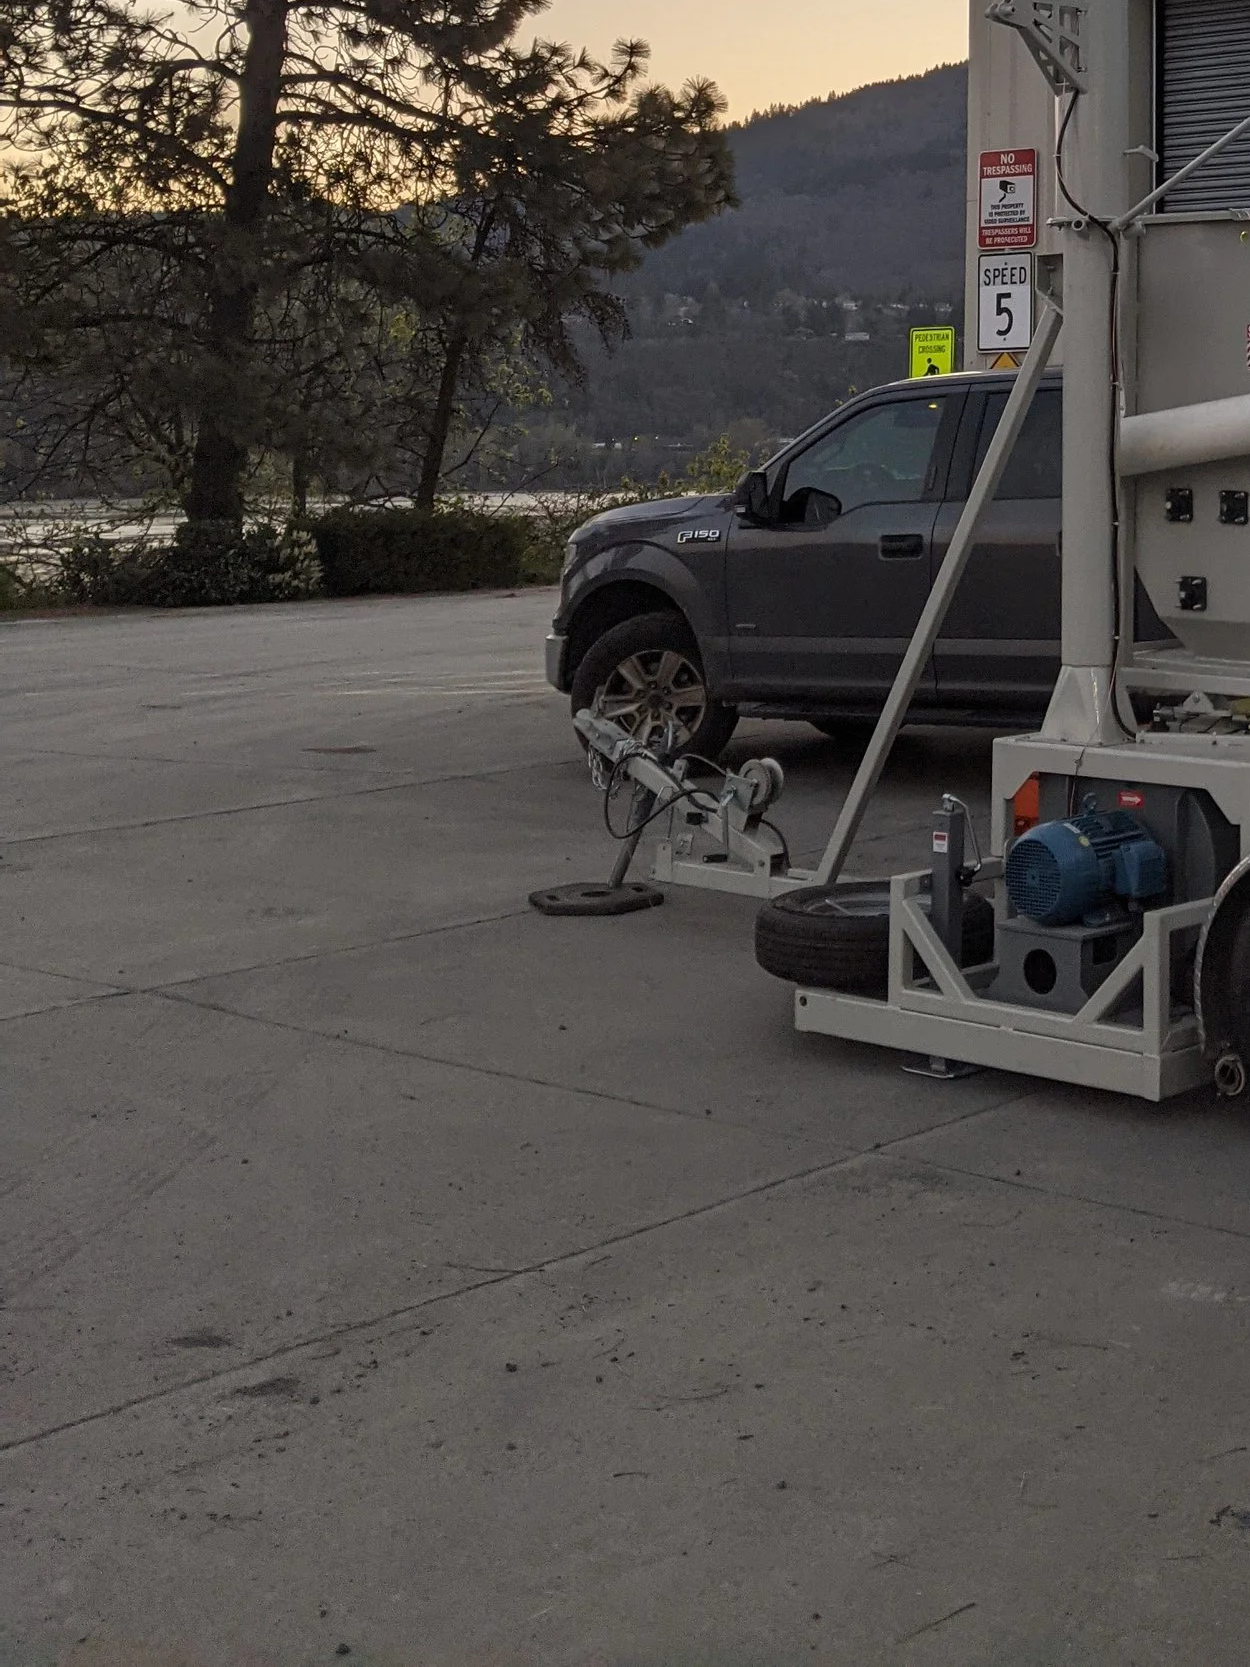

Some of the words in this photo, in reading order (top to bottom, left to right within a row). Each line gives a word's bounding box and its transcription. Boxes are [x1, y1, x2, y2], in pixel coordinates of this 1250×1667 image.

[1000, 153, 1015, 164] NO
[983, 164, 1032, 176] TRESPASSING
[998, 216, 1030, 224] SURVEILLANCE
[982, 227, 1018, 236] TRESPASSERS
[986, 237, 992, 245] BE
[994, 236, 1028, 244] PROSECUTED
[983, 266, 1027, 287] SPEED
[995, 292, 1014, 337] 5
[914, 333, 950, 343] PEDESTRIAN
[918, 345, 946, 355] CROSSING
